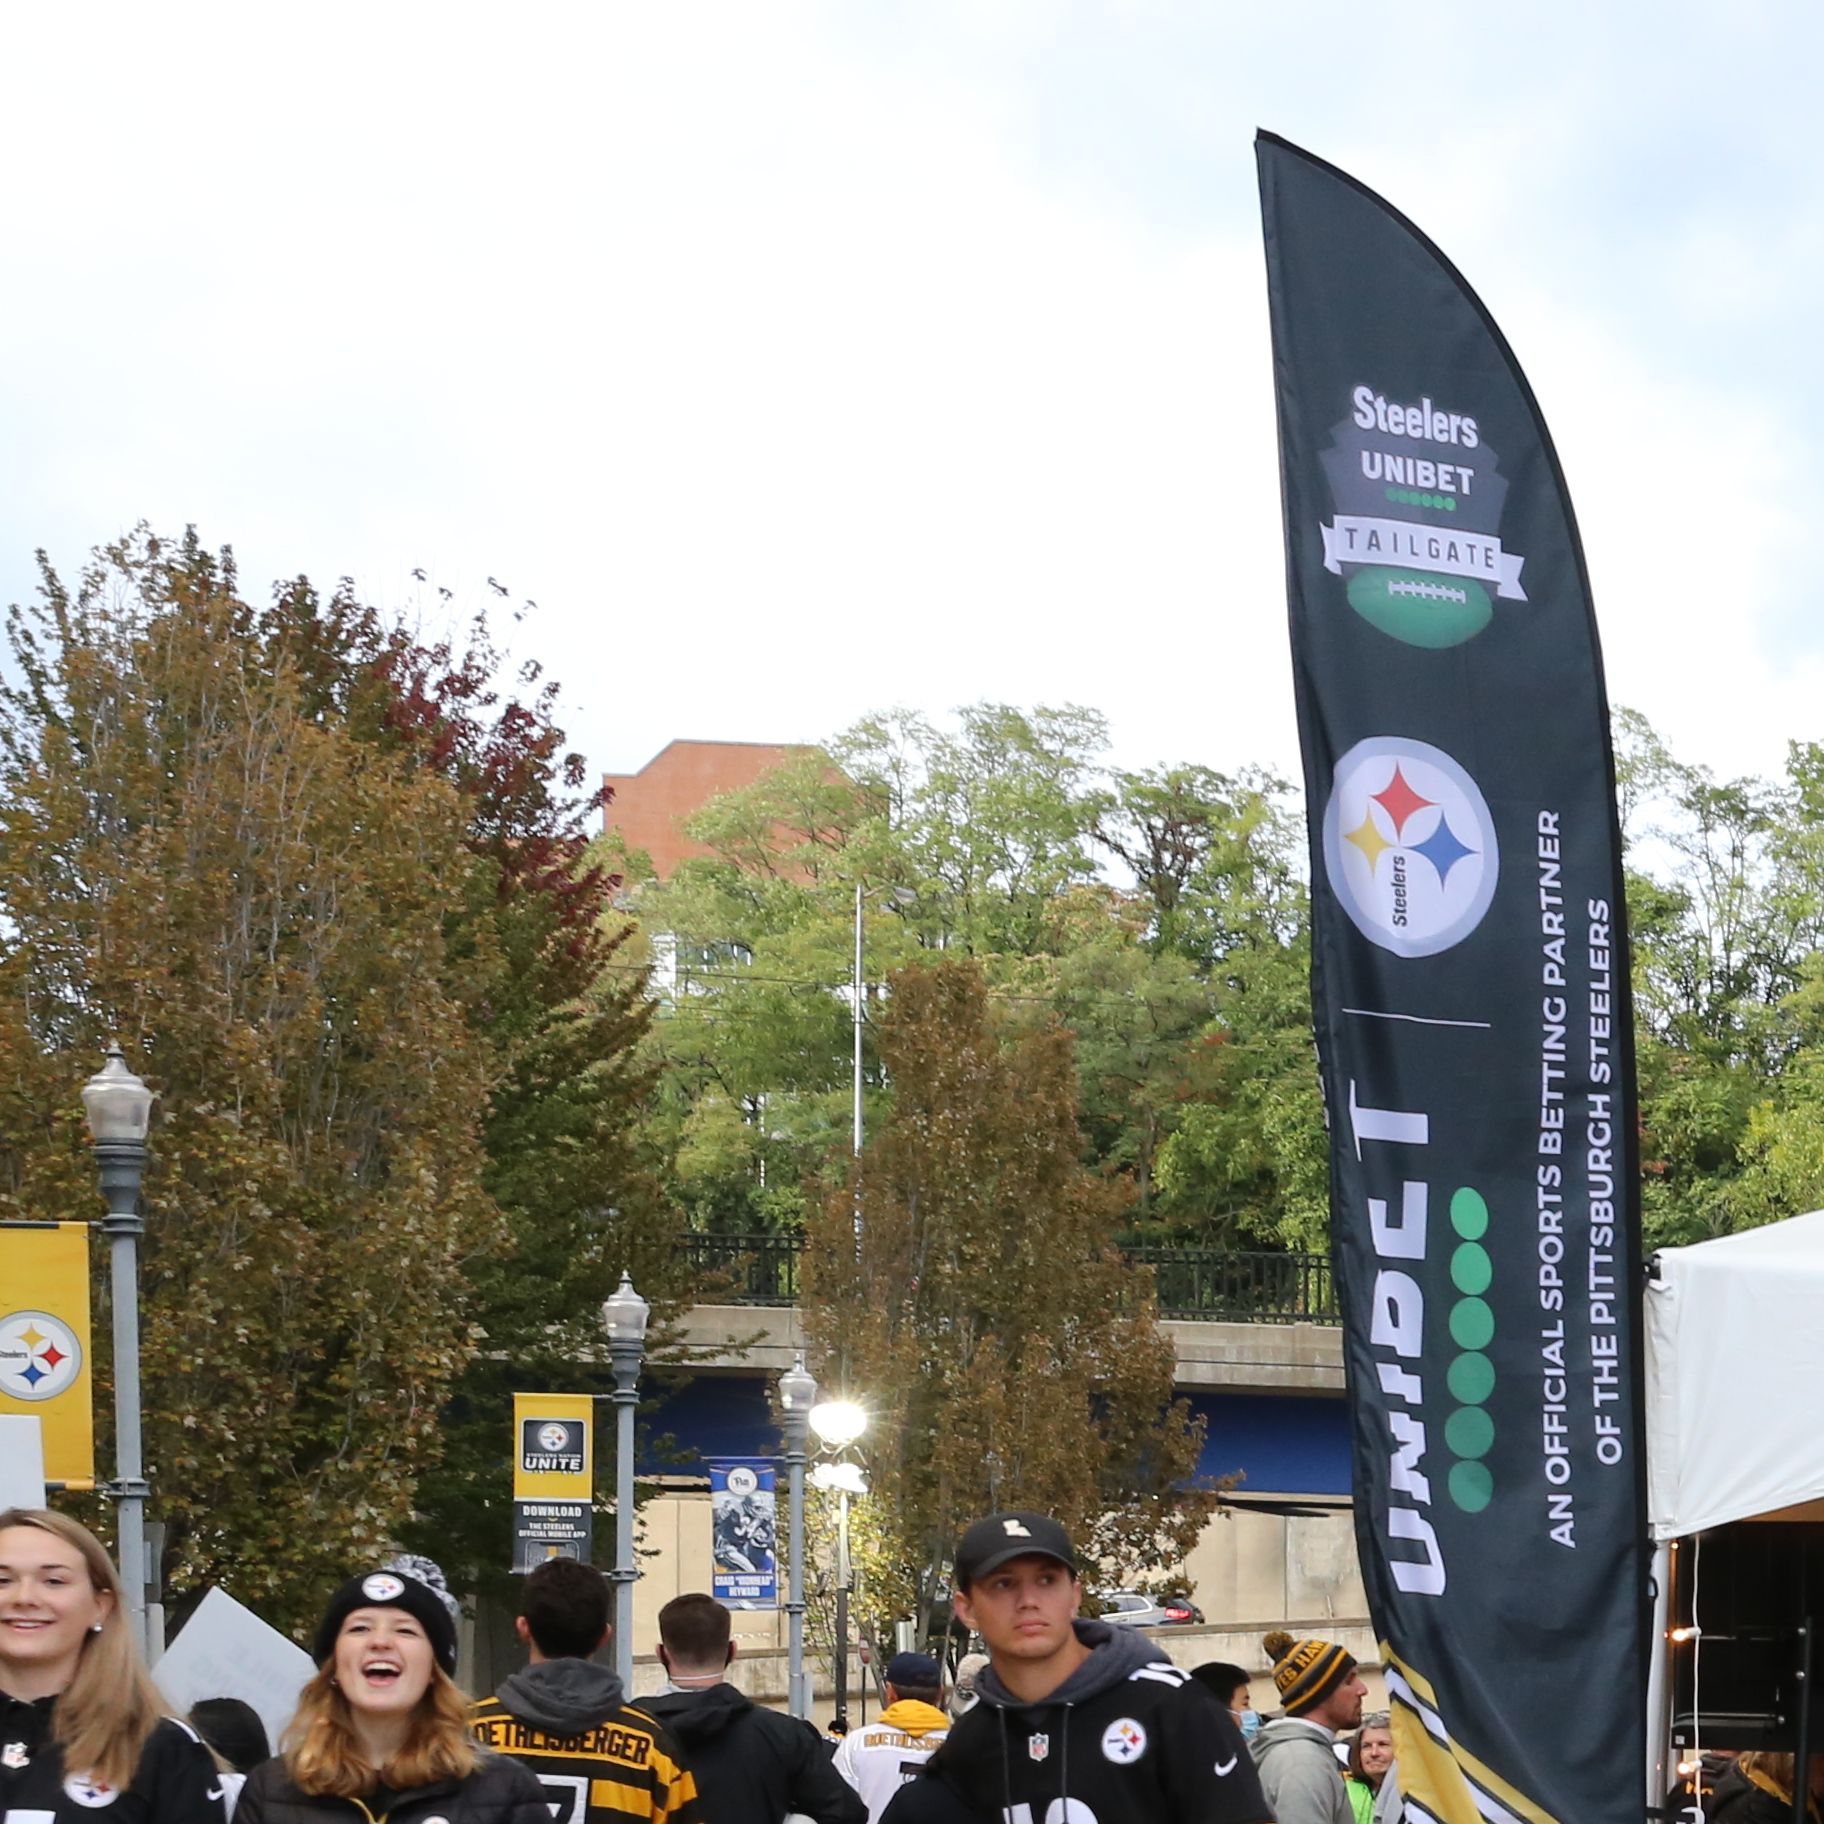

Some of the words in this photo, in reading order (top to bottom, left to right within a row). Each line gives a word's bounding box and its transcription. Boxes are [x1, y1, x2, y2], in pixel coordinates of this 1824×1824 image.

[1353, 385, 1479, 448] Steelers
[1361, 450, 1475, 495] UNIBET
[1344, 527, 1495, 569] TAILGATE
[1390, 855, 1406, 927] Steelers
[1537, 809, 1567, 987] PARTNER
[1587, 898, 1611, 1085] STEELERS
[1538, 1004, 1567, 1154] BETTING
[1537, 1164, 1564, 1311] SPORTS
[1587, 1094, 1616, 1325] PITTSBURGH
[1541, 1319, 1571, 1485] OFFICIAL
[1592, 1335, 1619, 1409] THE
[525, 1457, 582, 1471] UNITE
[1596, 1415, 1623, 1466] OF
[522, 1505, 583, 1517] DOWNLOAD
[529, 1522, 542, 1530] THE
[1549, 1494, 1575, 1549] AN
